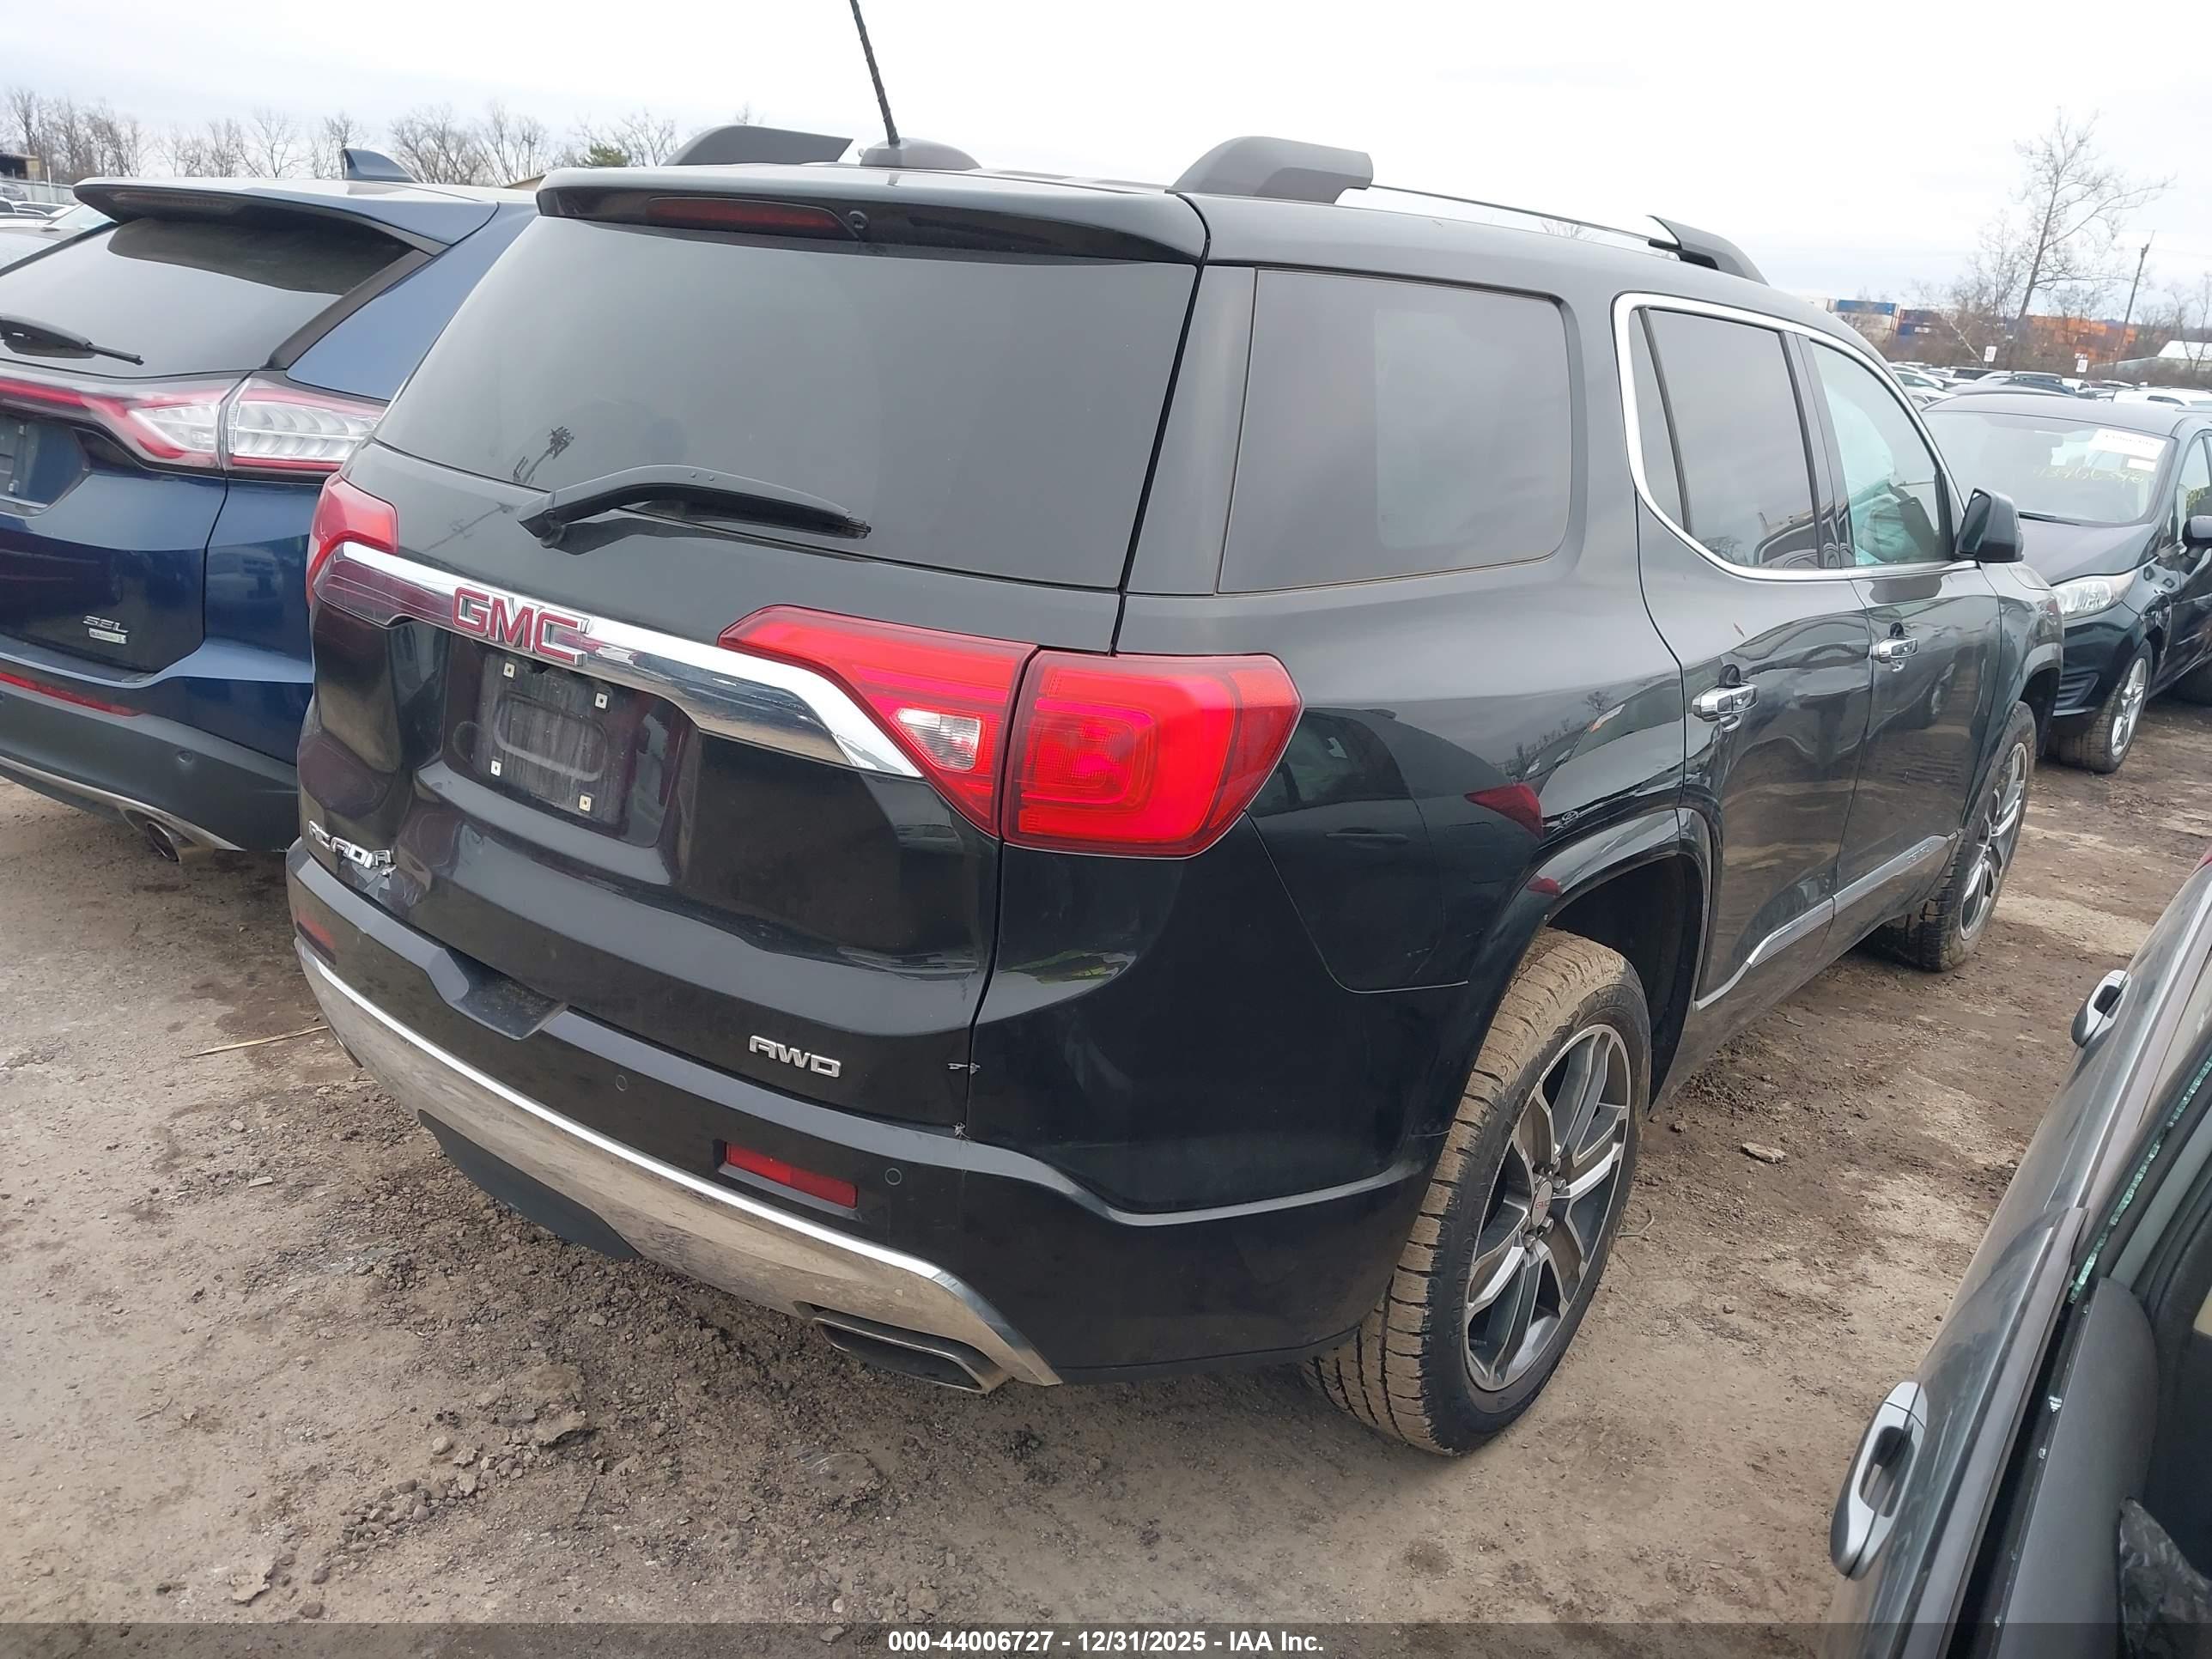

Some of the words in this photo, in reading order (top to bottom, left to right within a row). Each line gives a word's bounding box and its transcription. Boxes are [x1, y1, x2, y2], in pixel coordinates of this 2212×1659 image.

[82, 615, 129, 633] SEL
[453, 586, 588, 667] GMC
[309, 820, 392, 869] ACADIA
[749, 1035, 841, 1078] AWD
